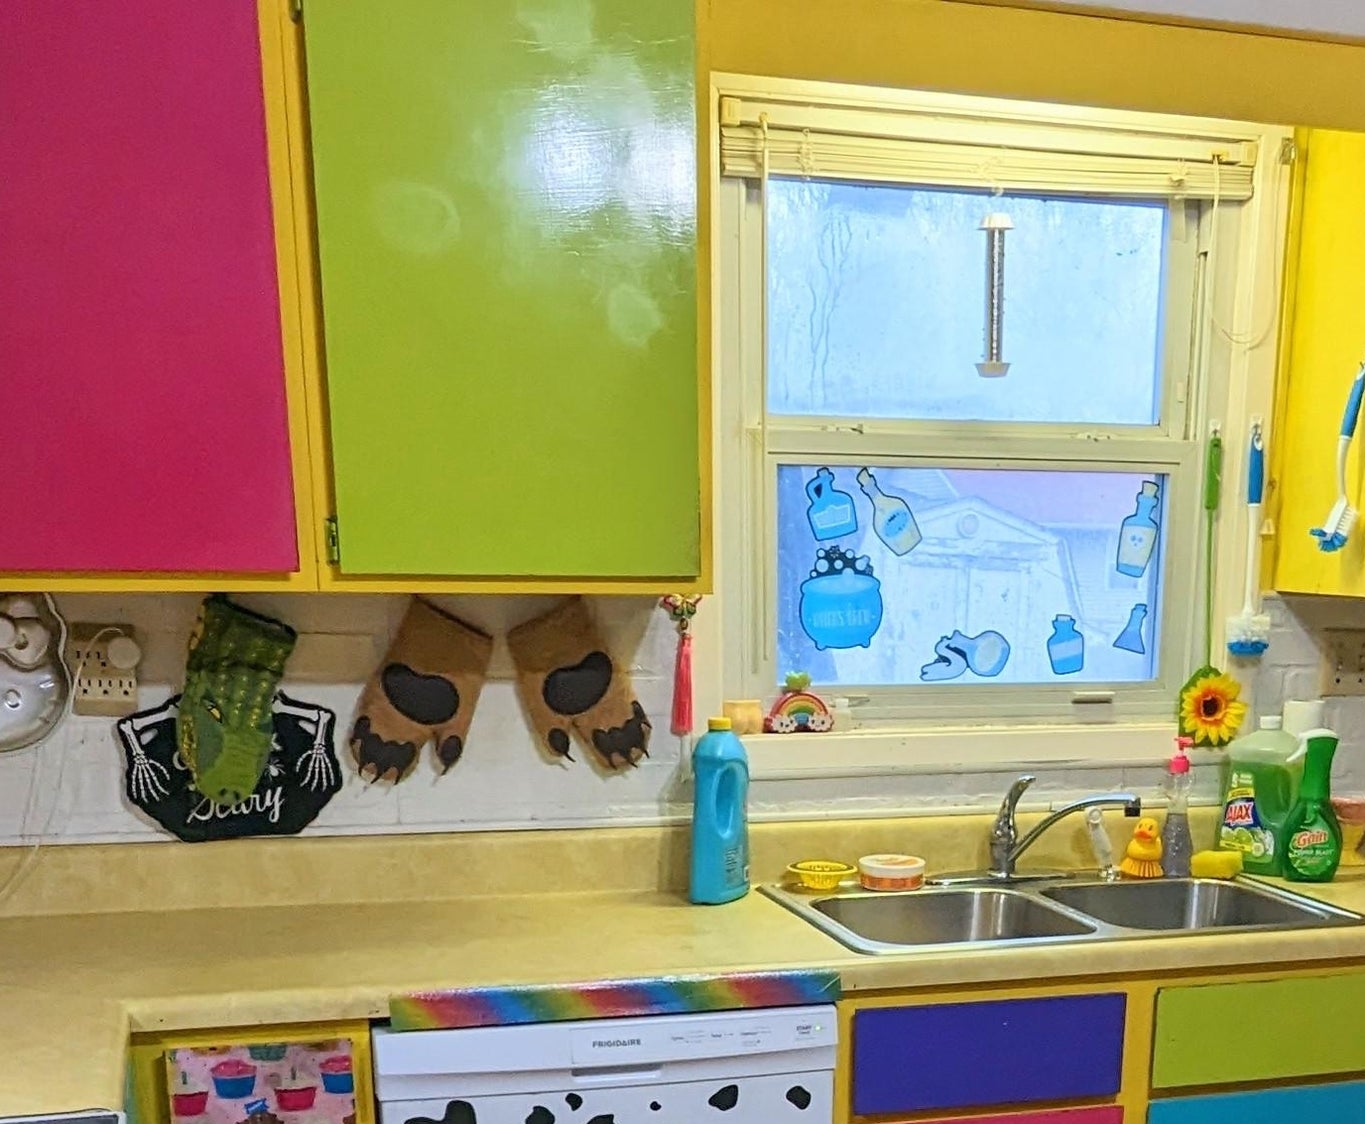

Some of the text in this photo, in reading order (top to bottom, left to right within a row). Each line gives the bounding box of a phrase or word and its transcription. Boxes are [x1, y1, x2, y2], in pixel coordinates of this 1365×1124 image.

[1225, 803, 1252, 825] AJAX
[1296, 830, 1328, 848] Gain
[592, 1038, 642, 1049] FRIGIDAIRE
